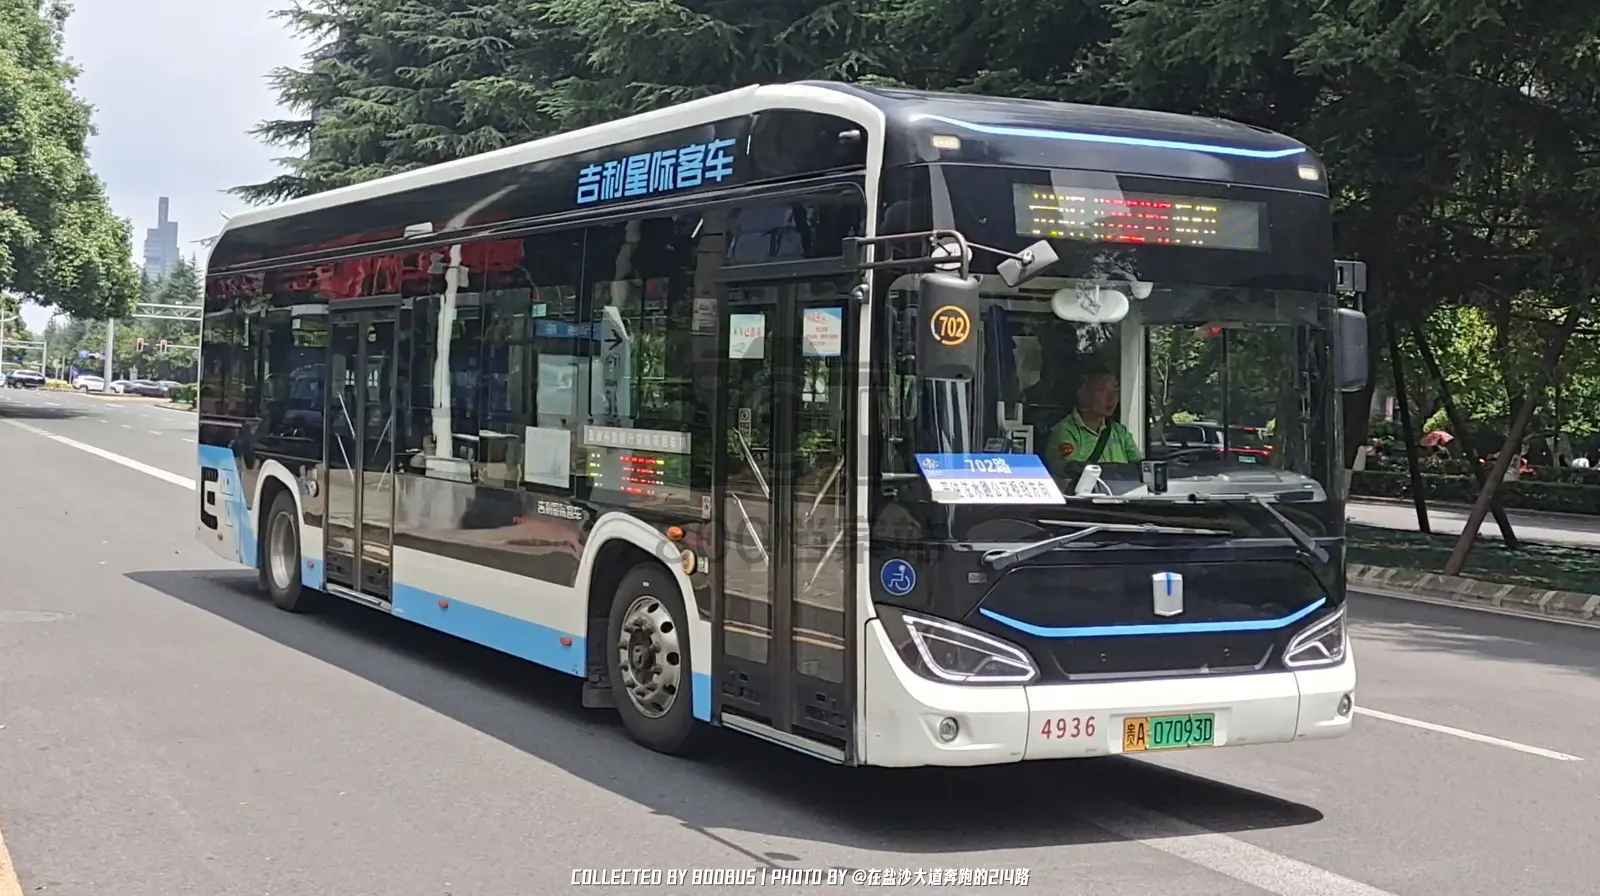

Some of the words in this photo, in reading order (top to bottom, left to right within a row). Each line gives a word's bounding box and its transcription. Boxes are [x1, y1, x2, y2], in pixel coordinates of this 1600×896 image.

[577, 138, 736, 204] 吉利星际客车
[939, 315, 965, 338] 702
[964, 457, 1012, 474] 702路
[1041, 716, 1096, 739] 4936
[1153, 718, 1213, 744] 07093D
